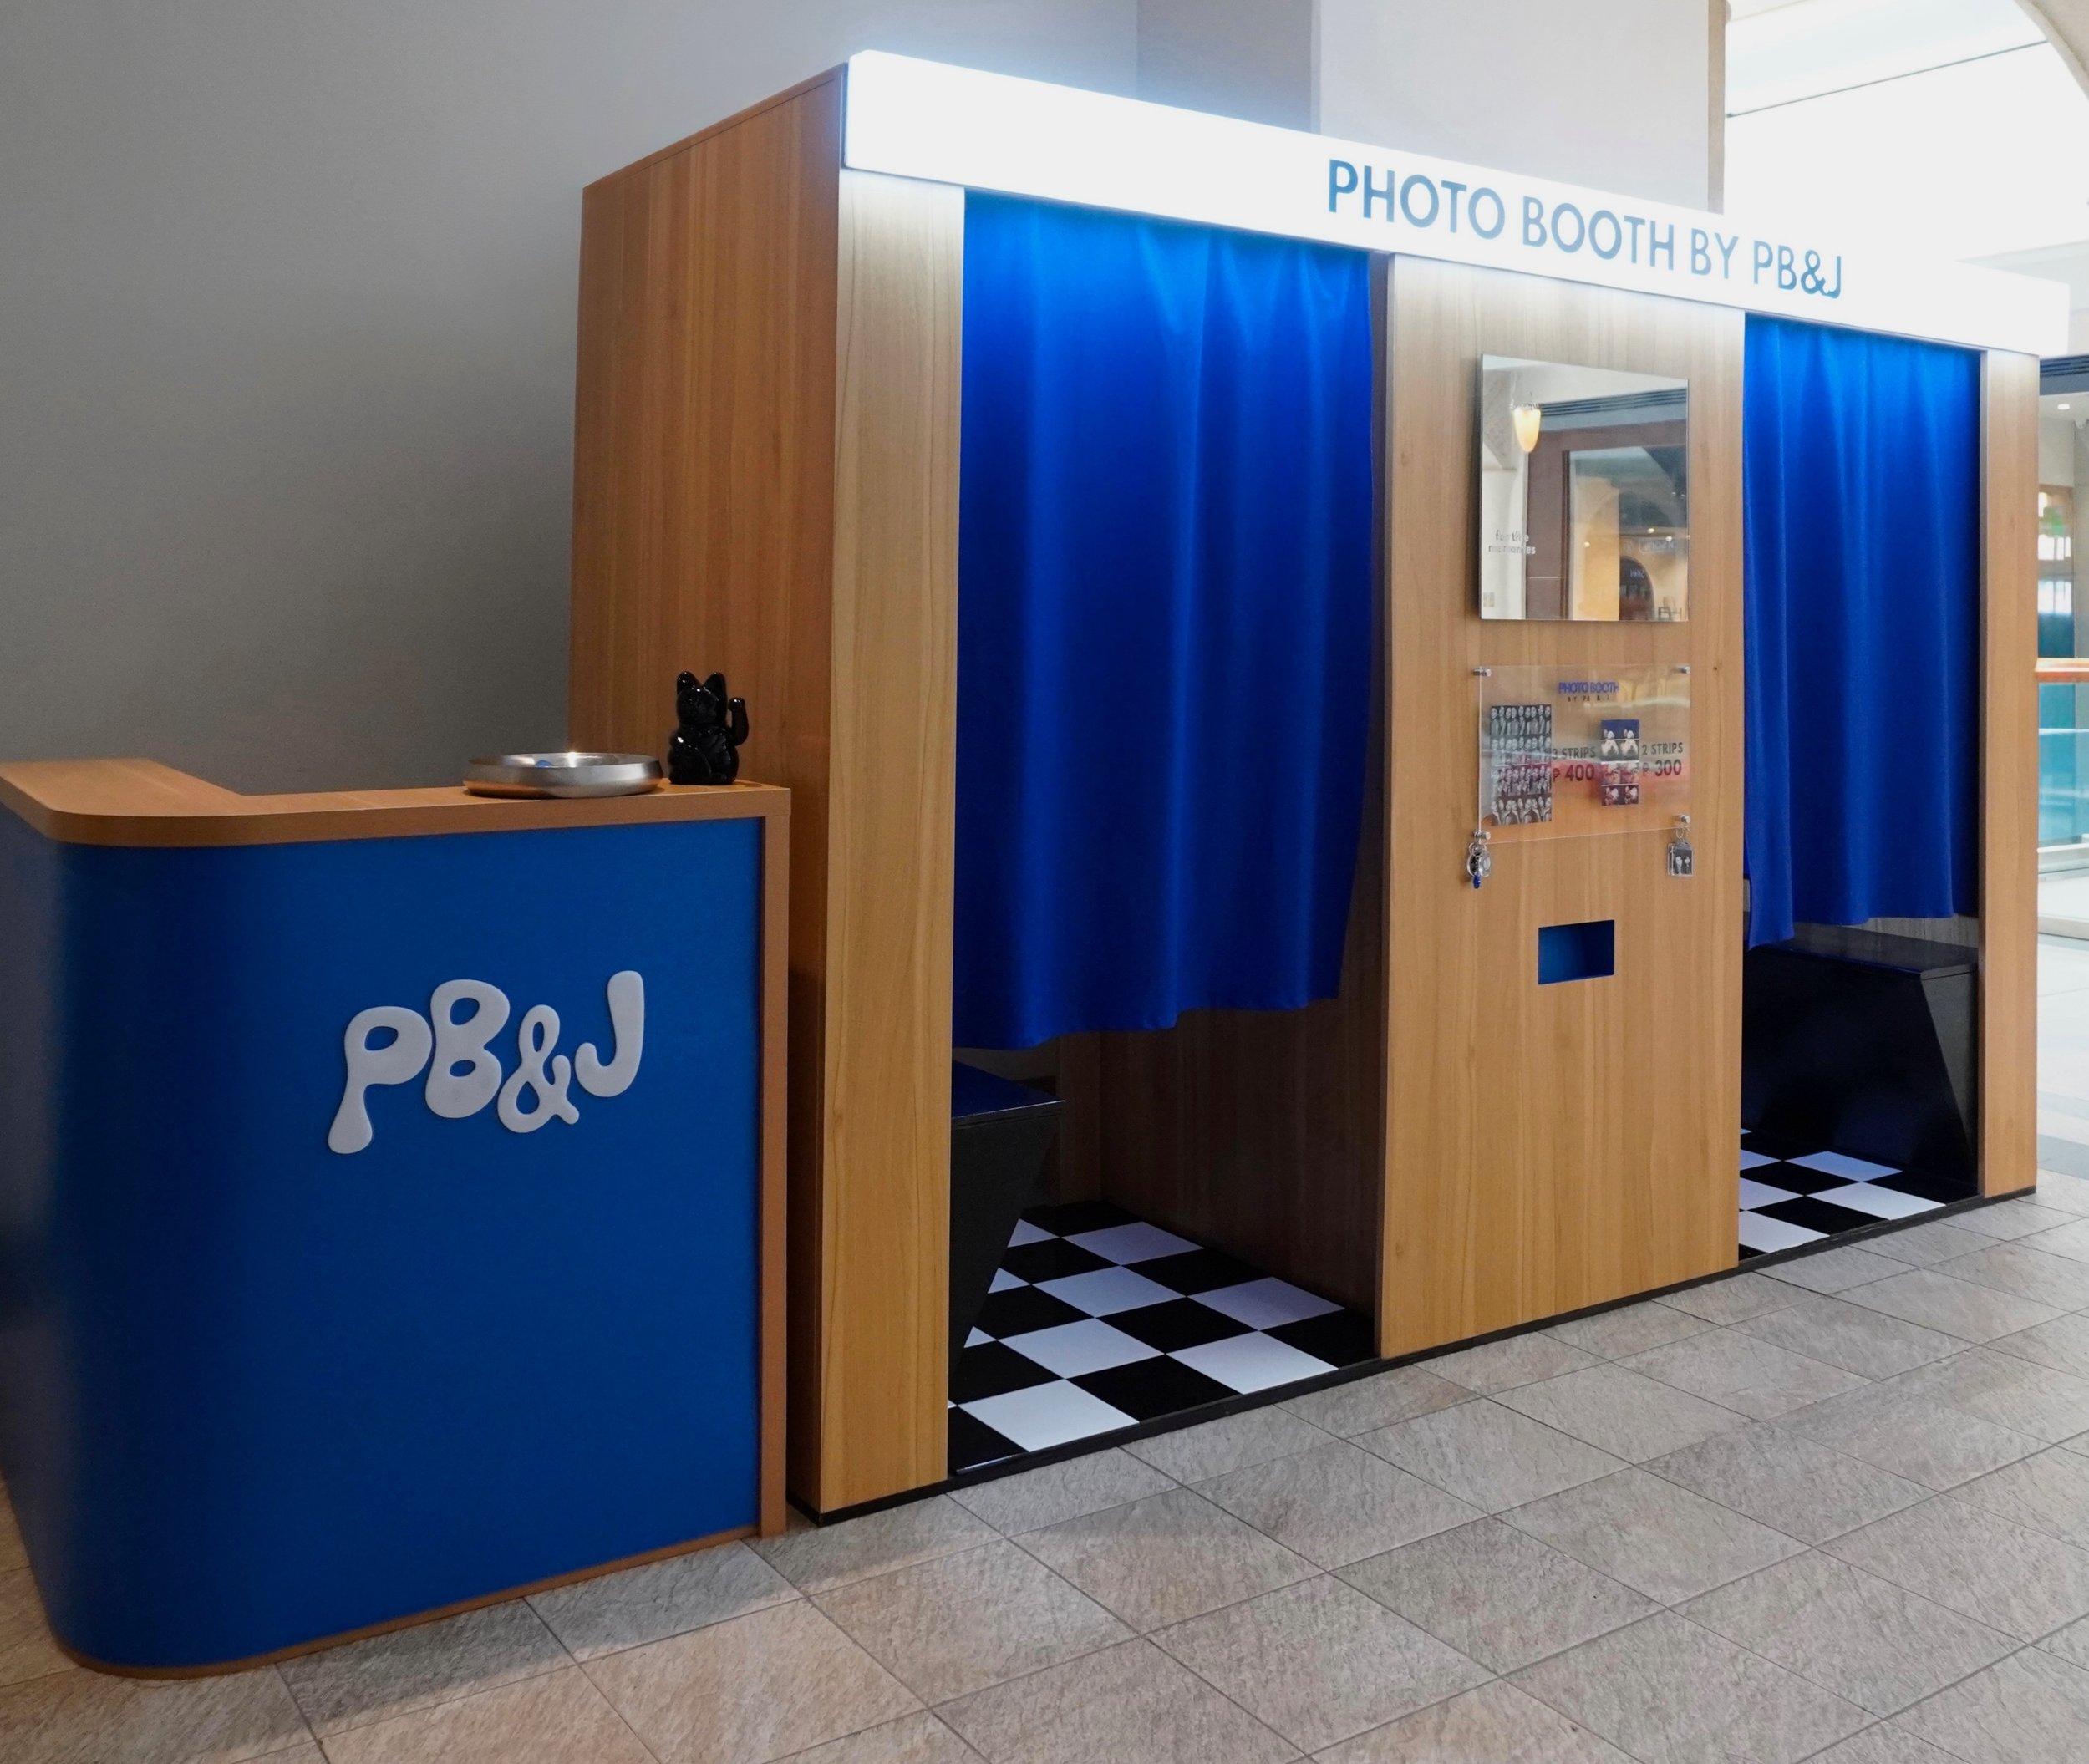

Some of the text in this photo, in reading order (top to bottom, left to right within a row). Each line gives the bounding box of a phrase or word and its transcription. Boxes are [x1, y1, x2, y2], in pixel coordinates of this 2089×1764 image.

[1328, 158, 1842, 299] PHOTO BOOTH BY PB&J
[1558, 681, 1619, 694] PHOTO BOOTH
[1553, 746, 1596, 760] 3 STRIPS
[1641, 742, 1683, 755] 2 STRIPS
[1564, 763, 1594, 781] 400
[1655, 759, 1681, 776] 300
[328, 970, 645, 1154] PB&J
